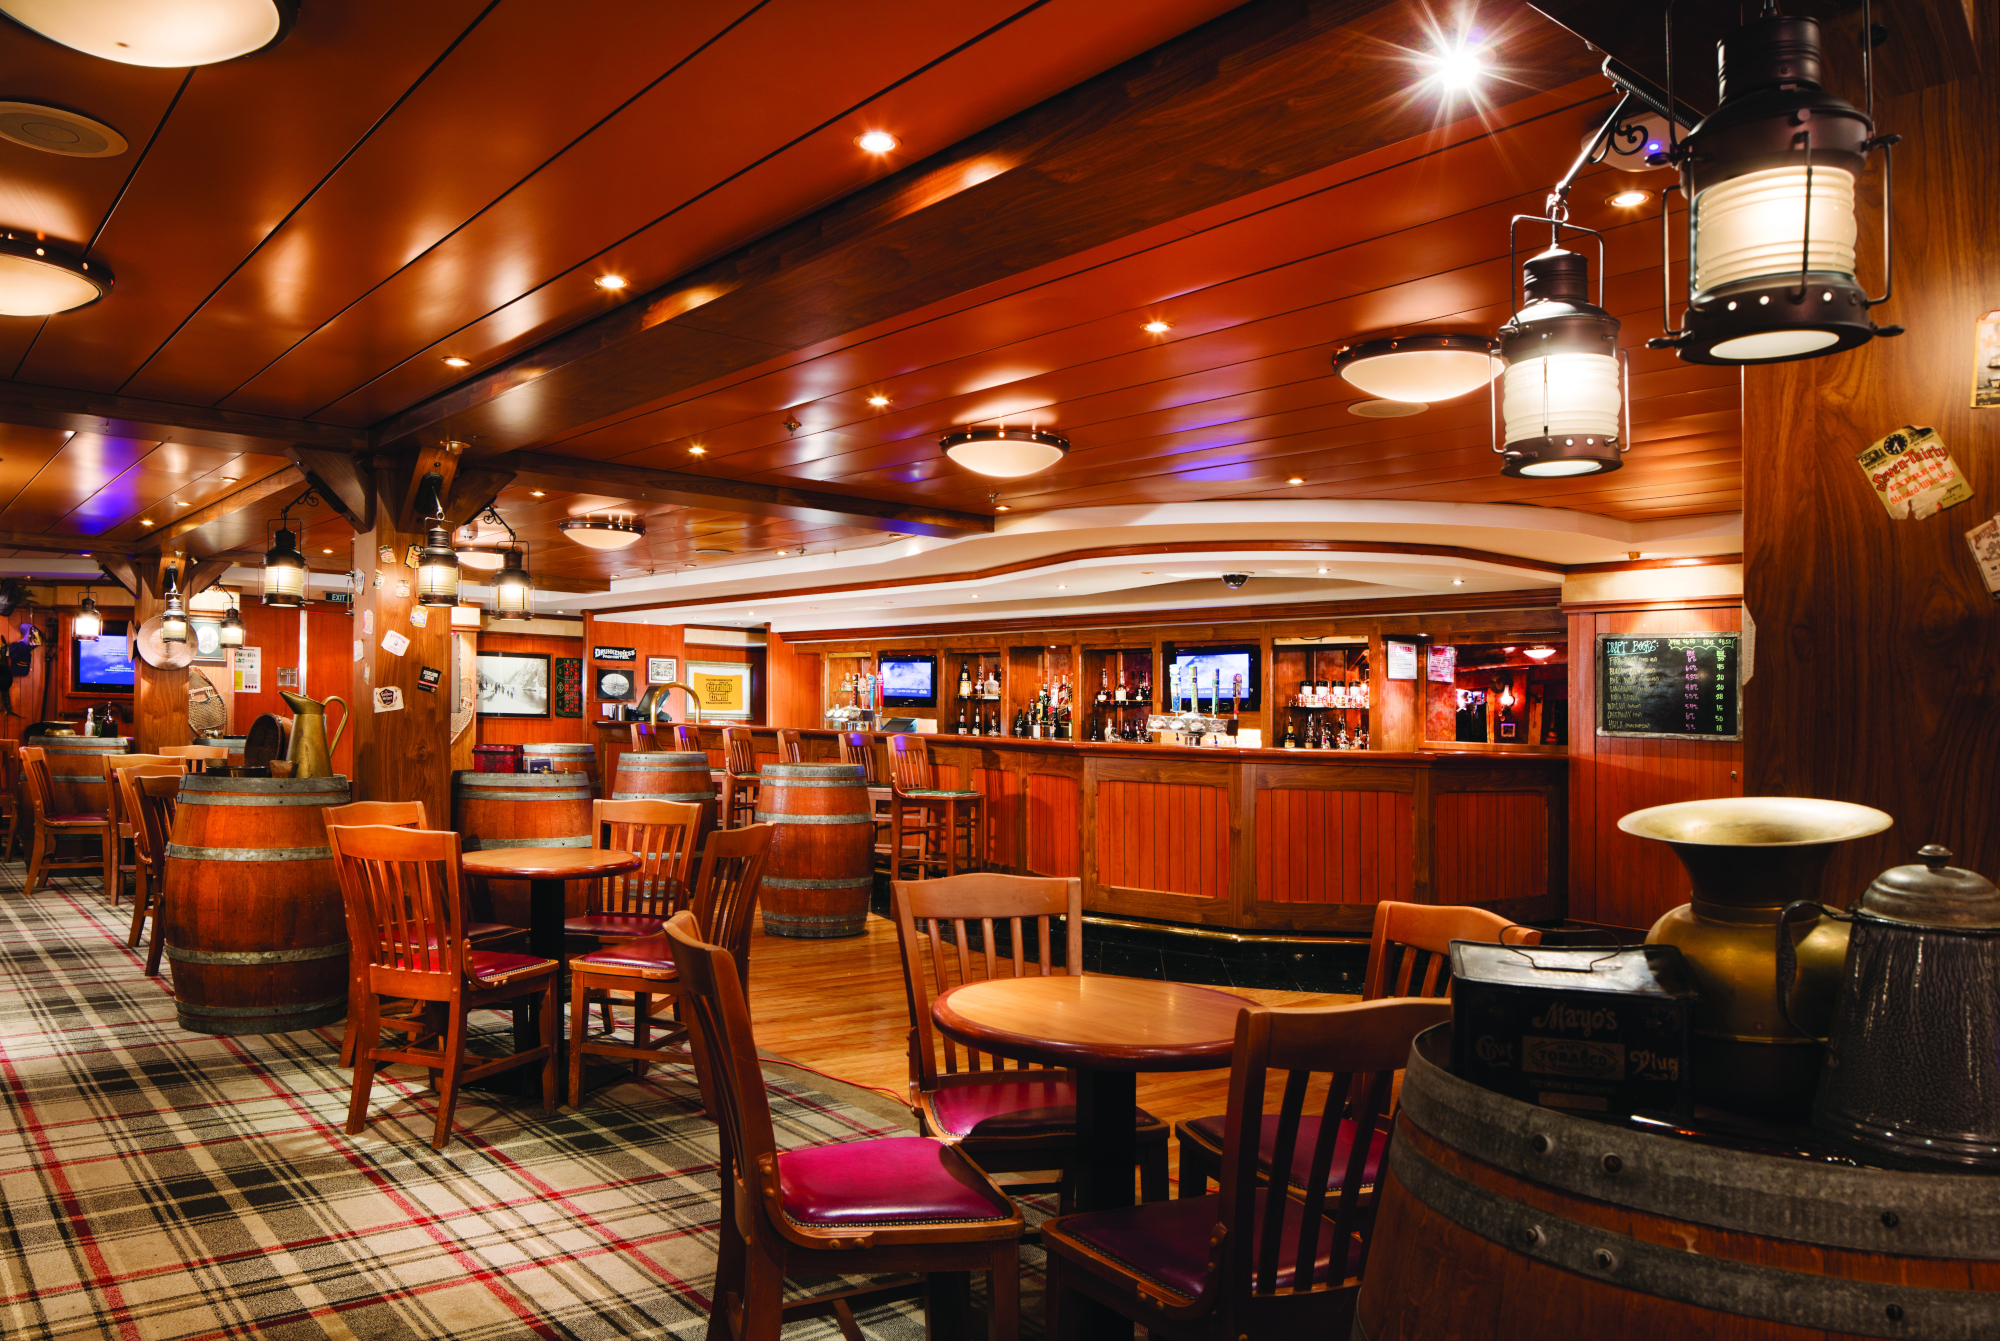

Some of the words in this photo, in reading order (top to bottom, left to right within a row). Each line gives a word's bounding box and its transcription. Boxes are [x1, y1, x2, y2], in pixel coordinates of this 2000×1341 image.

[1872, 445, 1949, 492] Seven-Thirty
[1889, 461, 1943, 492] EXPRESS
[1890, 485, 1920, 505] Blended
[1920, 470, 1955, 490] Whiskey
[332, 593, 346, 602] EXIT
[595, 648, 636, 659] DRUNKENNESS
[1607, 641, 1628, 655] DRAFT
[1632, 640, 1659, 653] BEERS:
[706, 682, 733, 692] terrible
[709, 692, 729, 702] towel
[1716, 704, 1724, 712] 15
[1716, 724, 1723, 732] 18
[1531, 1001, 1618, 1037] Mayo's
[1476, 1034, 1514, 1063] Cut
[1538, 1049, 1608, 1067] TOBACCO
[1629, 1048, 1680, 1082] Plug
